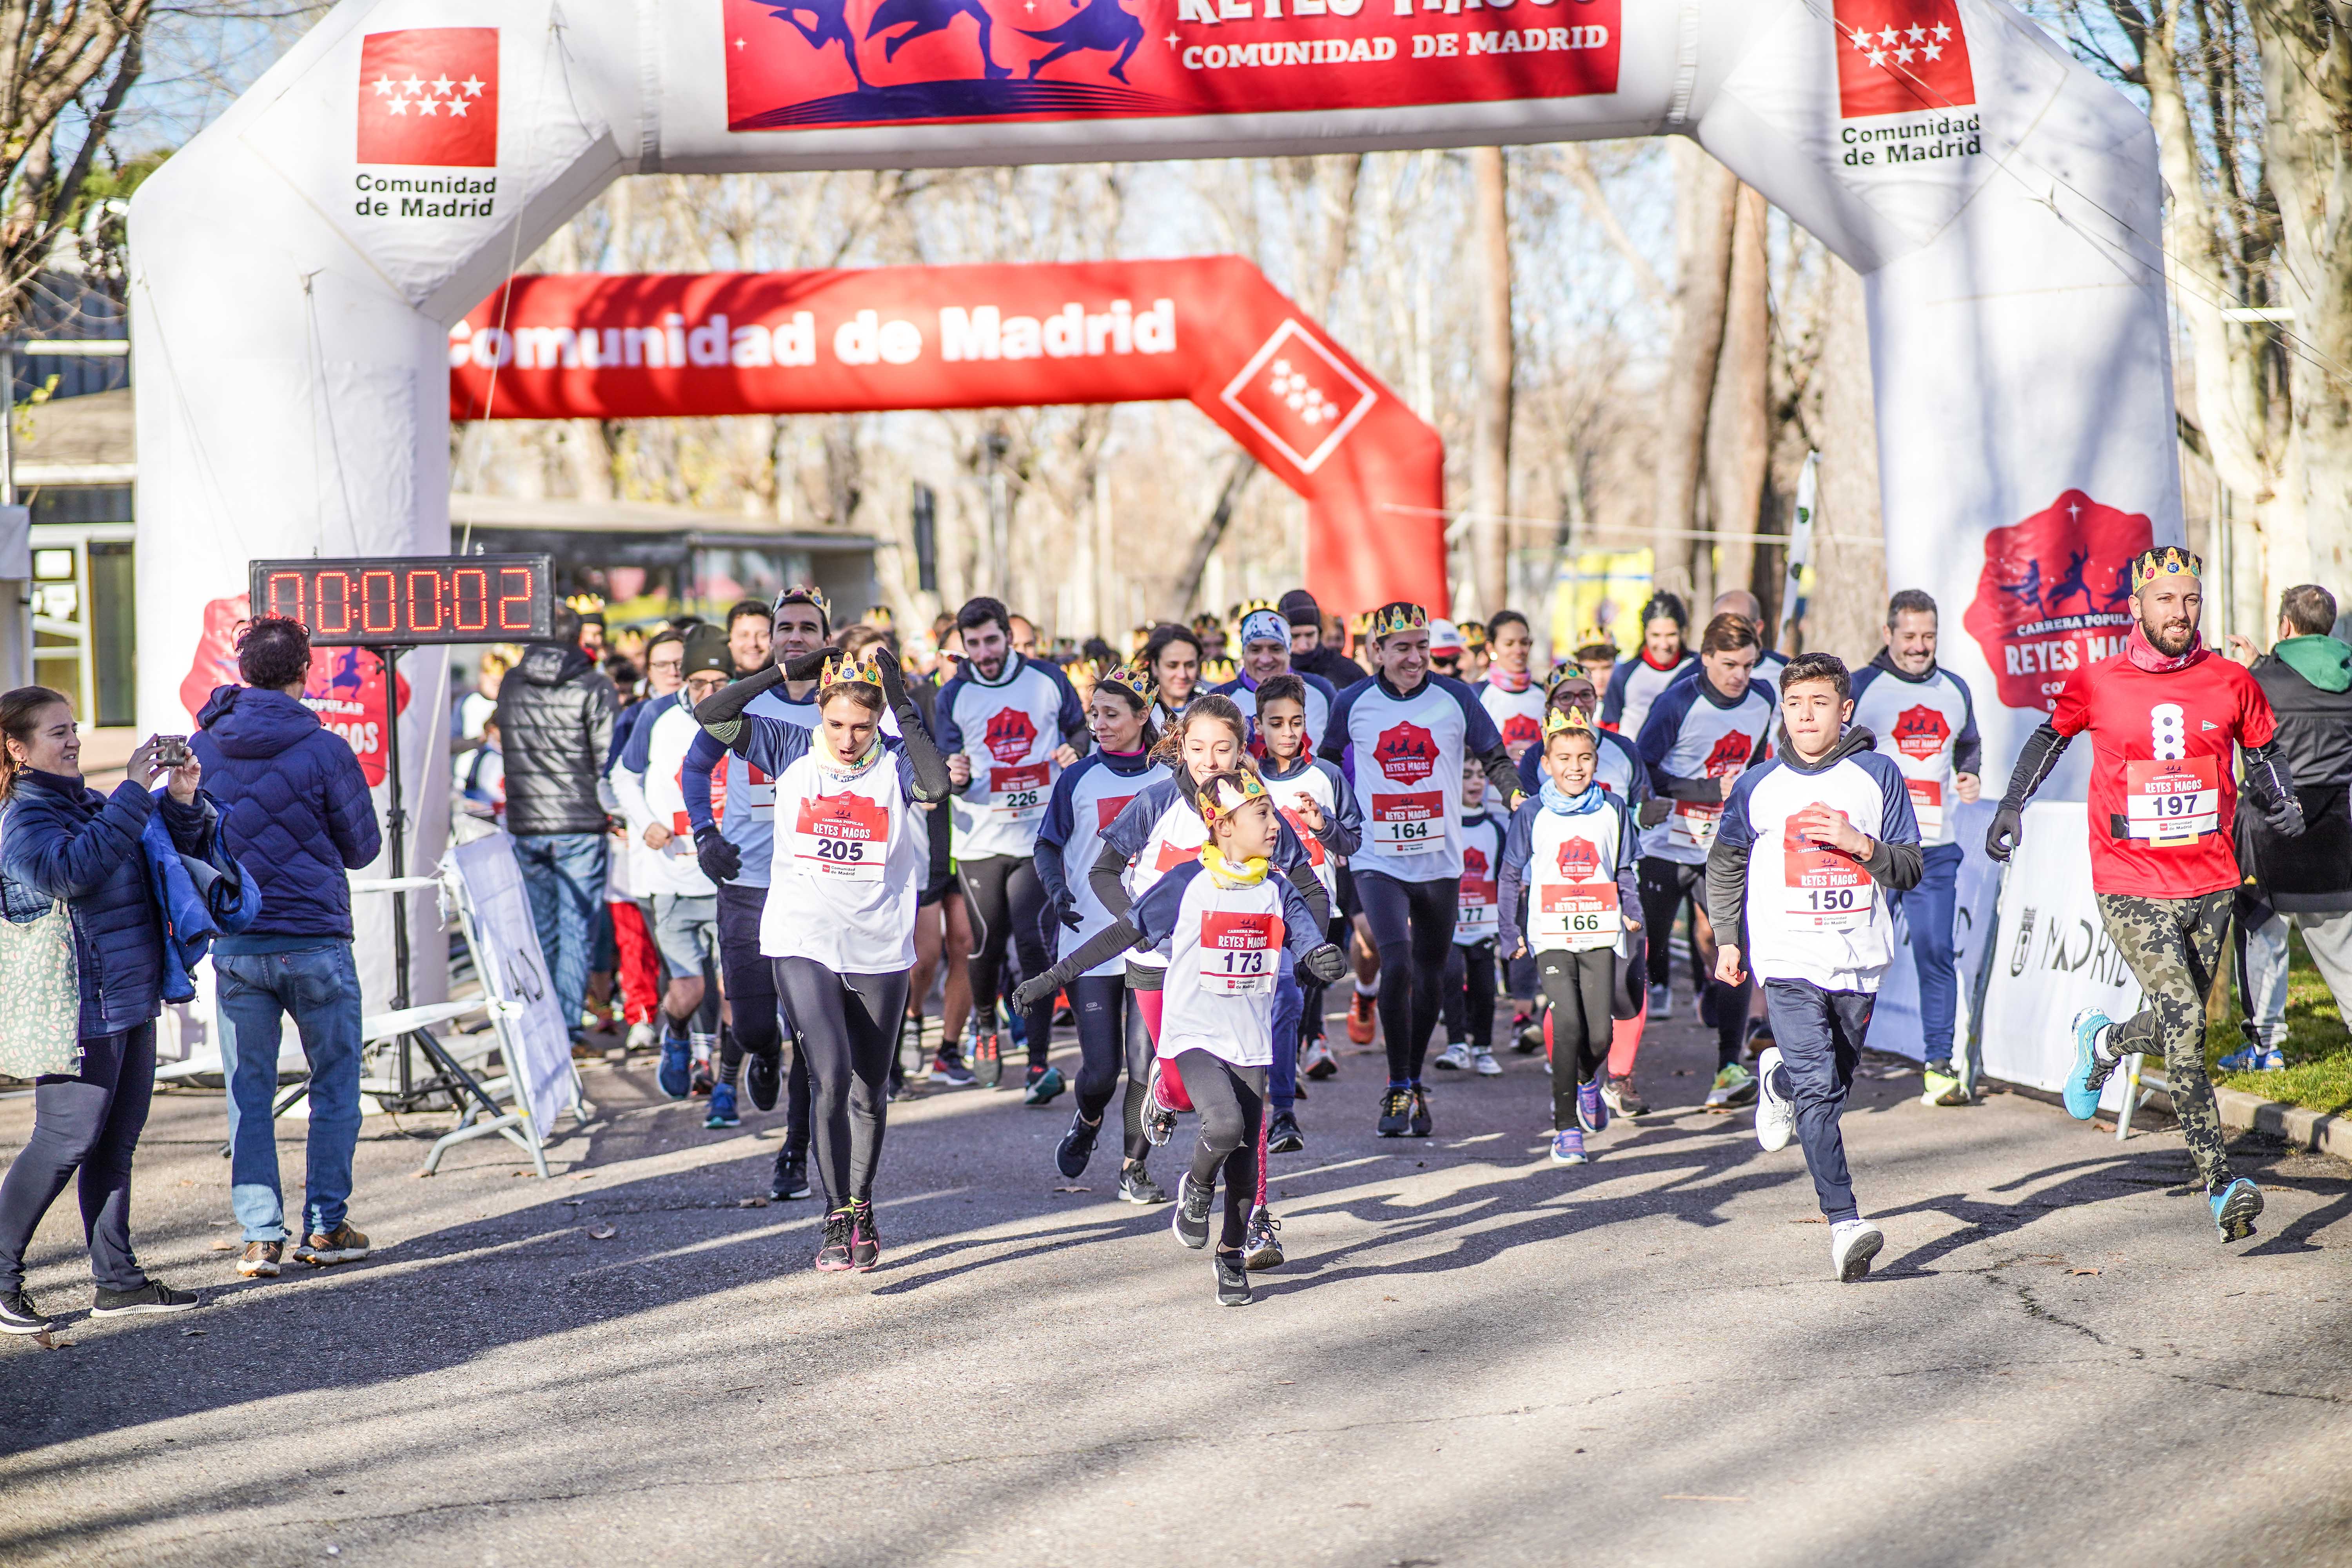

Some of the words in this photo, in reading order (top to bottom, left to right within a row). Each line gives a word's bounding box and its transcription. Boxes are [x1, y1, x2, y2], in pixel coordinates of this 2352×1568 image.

[1182, 37, 1397, 70] COMUNIDAD
[1412, 33, 1459, 58] DE
[1466, 24, 1608, 55] MADRID
[1843, 114, 1980, 143] Comunidad
[1844, 149, 1875, 165] de
[1887, 135, 1981, 163] Madrid
[356, 174, 497, 193] Comunidad
[356, 197, 389, 216] de
[401, 198, 494, 217] Madrid
[834, 309, 922, 365] de
[940, 298, 1176, 361] Madrid
[2017, 616, 2083, 637] CARRERA
[2085, 613, 2134, 627] POPULA
[2004, 640, 2079, 675] REYES
[2145, 782, 2171, 793] REYES
[2174, 779, 2202, 792] MAGOS
[1007, 790, 1037, 807] 226
[2153, 794, 2197, 816] 197
[813, 823, 838, 836] REYES
[842, 827, 871, 839] MAGOS
[1391, 822, 1427, 838] 164
[818, 839, 863, 861] 205
[1801, 875, 1827, 886] REYES
[1830, 873, 1857, 886] MAGOS
[1809, 889, 1853, 910] 150
[1458, 907, 1483, 922] 77
[1562, 915, 1598, 930] 166
[1218, 935, 1244, 948] REYES
[1247, 936, 1267, 948] MAGOS
[1224, 952, 1262, 973] 173
